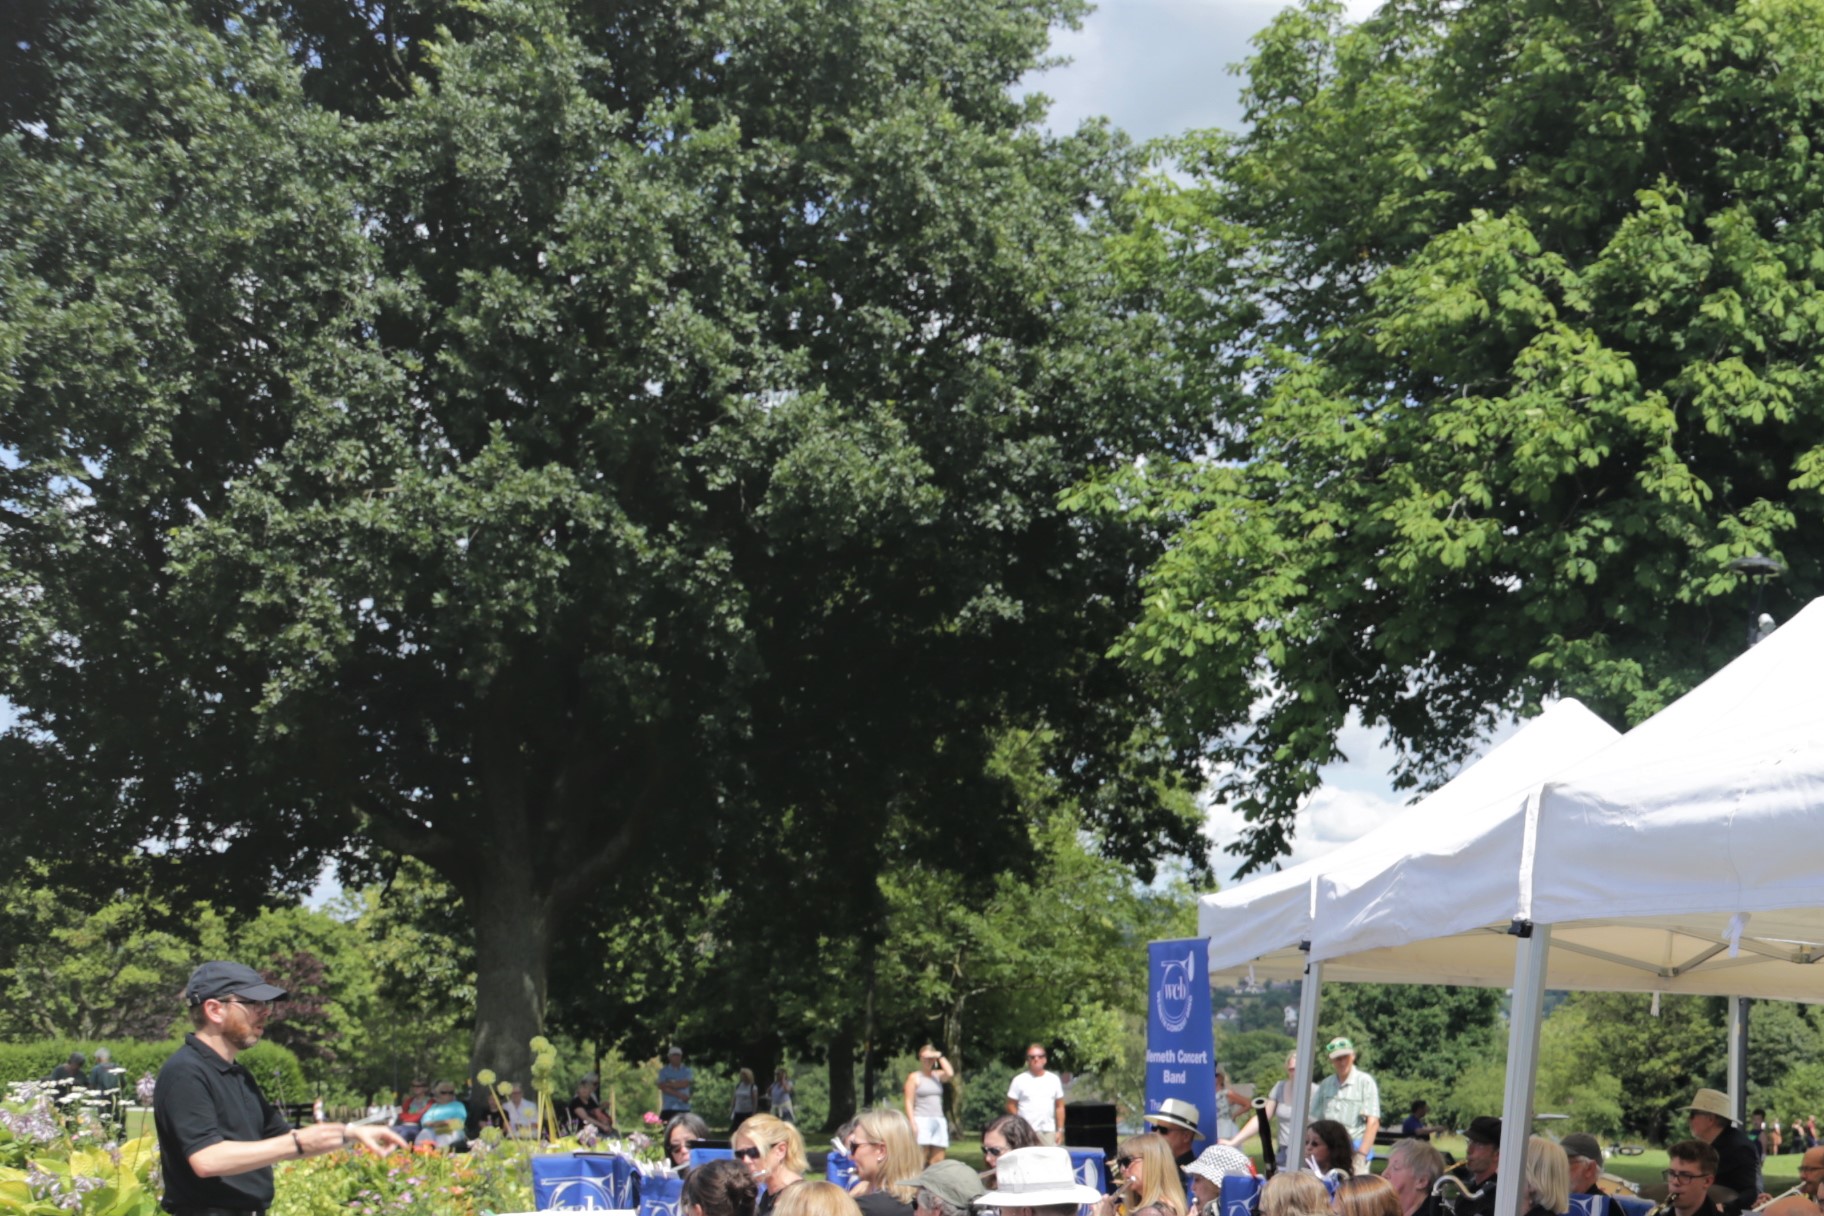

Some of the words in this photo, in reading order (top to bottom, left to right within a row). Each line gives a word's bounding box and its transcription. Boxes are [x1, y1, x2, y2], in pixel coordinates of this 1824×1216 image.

[1164, 976, 1187, 1000] wcb
[1177, 1050, 1208, 1064] Concert
[1163, 1070, 1187, 1084] Band
